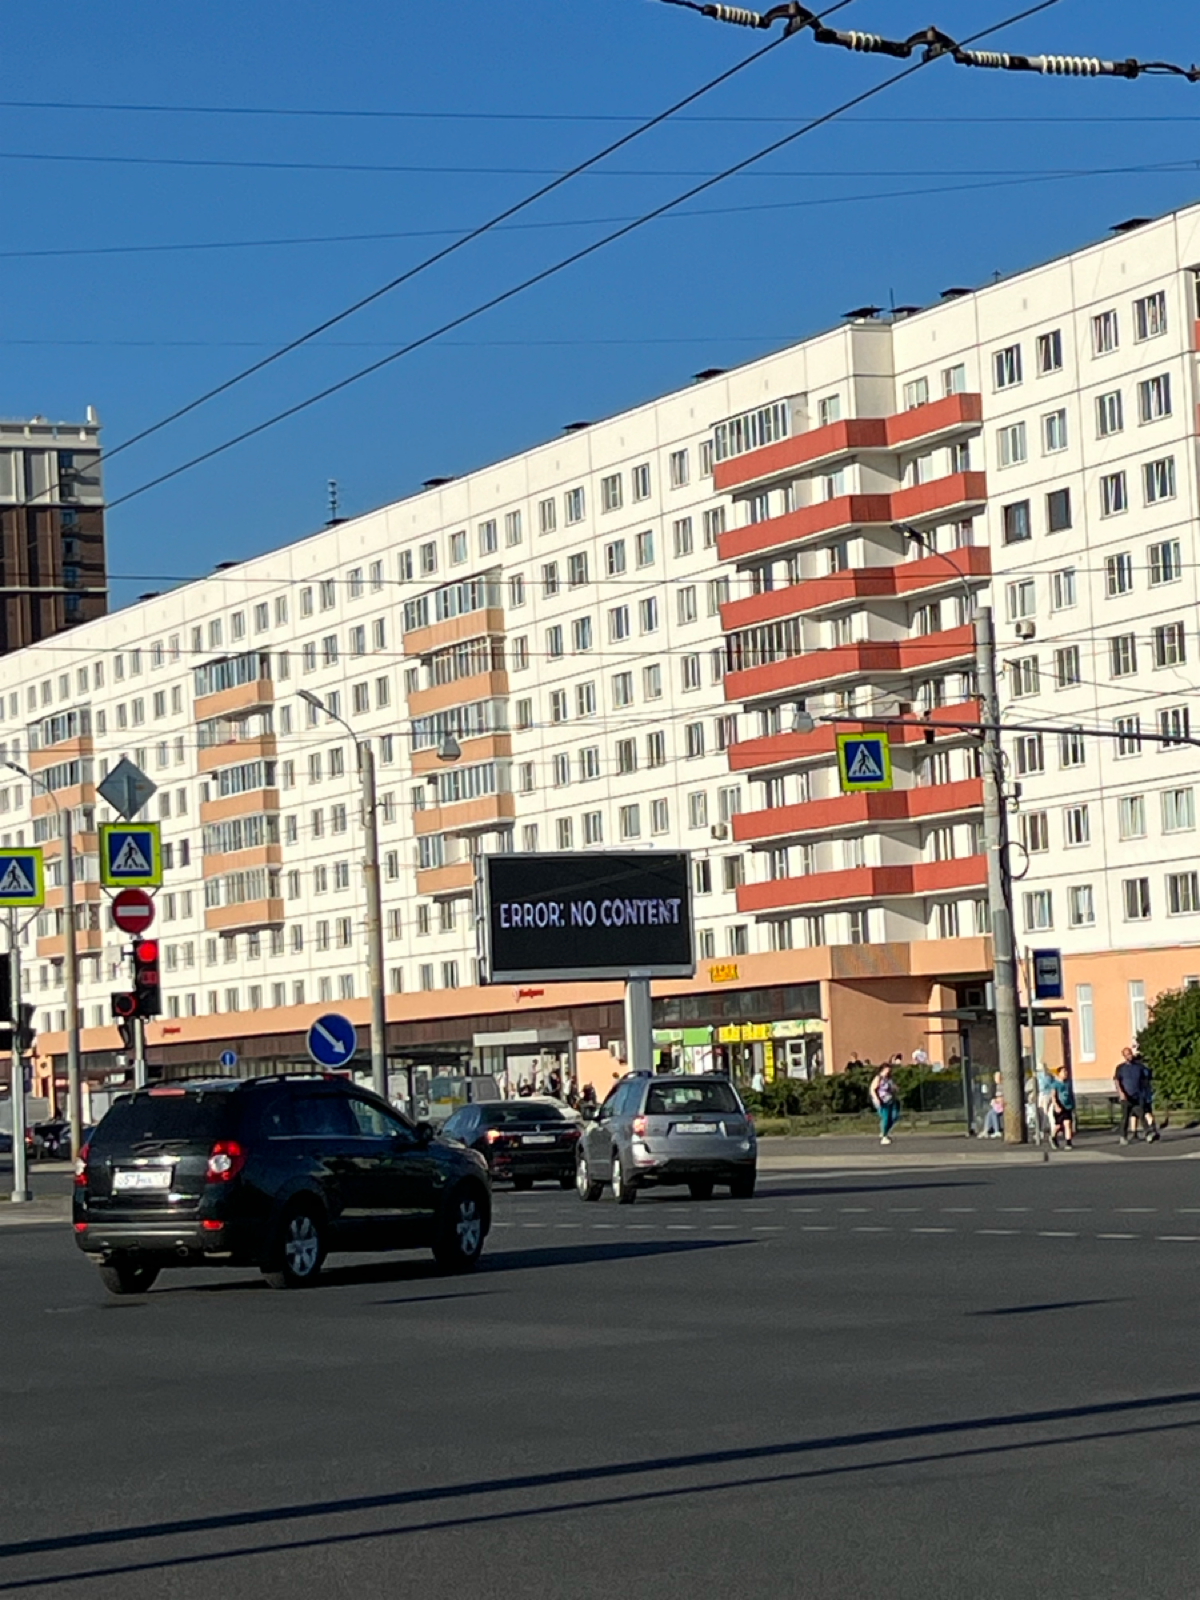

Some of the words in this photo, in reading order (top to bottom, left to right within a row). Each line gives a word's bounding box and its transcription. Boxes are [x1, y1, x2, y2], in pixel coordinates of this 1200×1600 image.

[500, 901, 565, 928] ERROR:
[571, 900, 596, 927] NO
[601, 898, 681, 927] CONTENT
